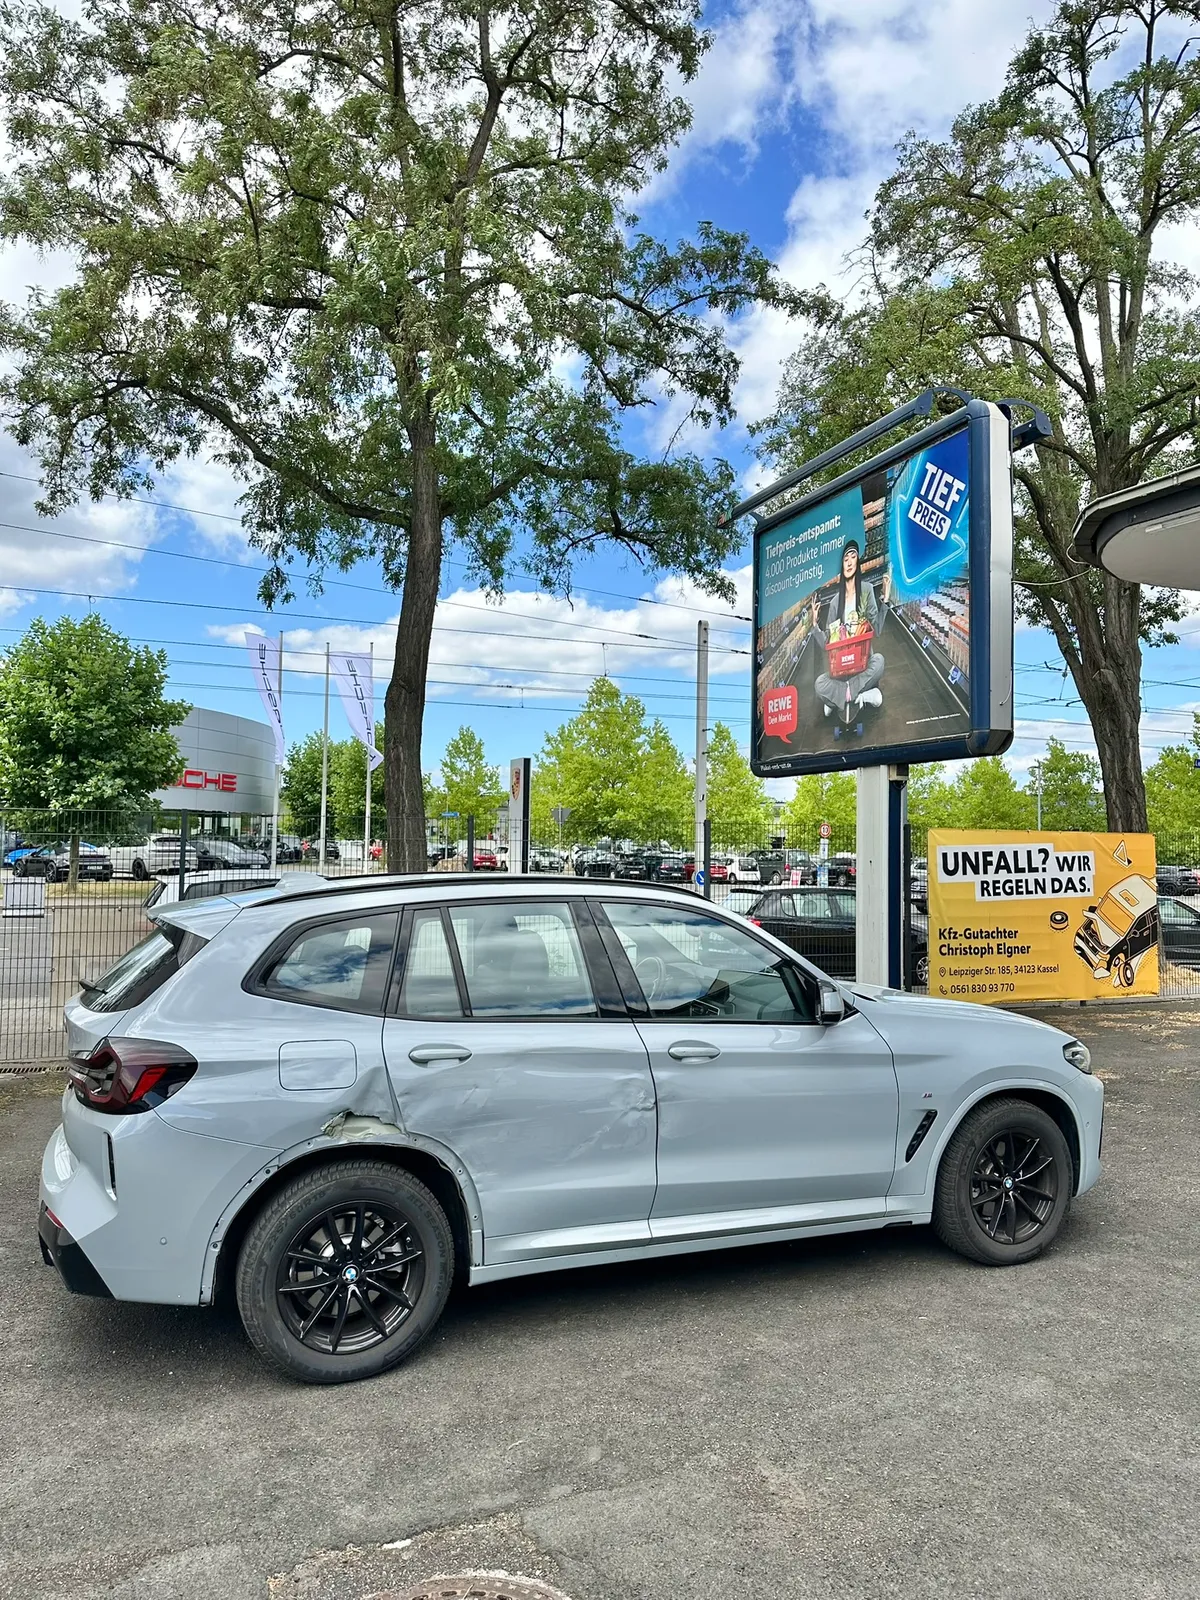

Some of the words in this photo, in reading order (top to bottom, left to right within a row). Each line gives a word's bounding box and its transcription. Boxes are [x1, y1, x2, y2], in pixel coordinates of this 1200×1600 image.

[919, 461, 967, 513] TIEF
[912, 500, 947, 536] PREIS
[765, 515, 842, 560] Tiefpreis-entspannt:
[765, 559, 785, 579] 4.000
[786, 547, 818, 571] Produkte
[820, 535, 846, 556] immer
[764, 562, 825, 597] discount-günstig.
[767, 695, 792, 713] REWE
[767, 714, 778, 725] Dein
[778, 712, 792, 722] Markt
[941, 848, 1050, 877] UNFALL?
[1055, 855, 1092, 872] WIR
[980, 877, 1047, 897] REGELN
[1050, 876, 1091, 894] DAS.
[938, 926, 1019, 940] Kfz-Gutachter
[938, 942, 994, 958] Christoph
[996, 942, 1031, 958] Elgner
[948, 966, 983, 978] Leipziger
[984, 966, 996, 975] Str.
[997, 965, 1013, 976] 185,
[1014, 964, 1036, 975] 34123
[1037, 964, 1060, 974] Kassel
[950, 984, 970, 994] 0561
[971, 984, 987, 993] 830
[989, 983, 999, 993] 93
[1000, 982, 1015, 992] 770
